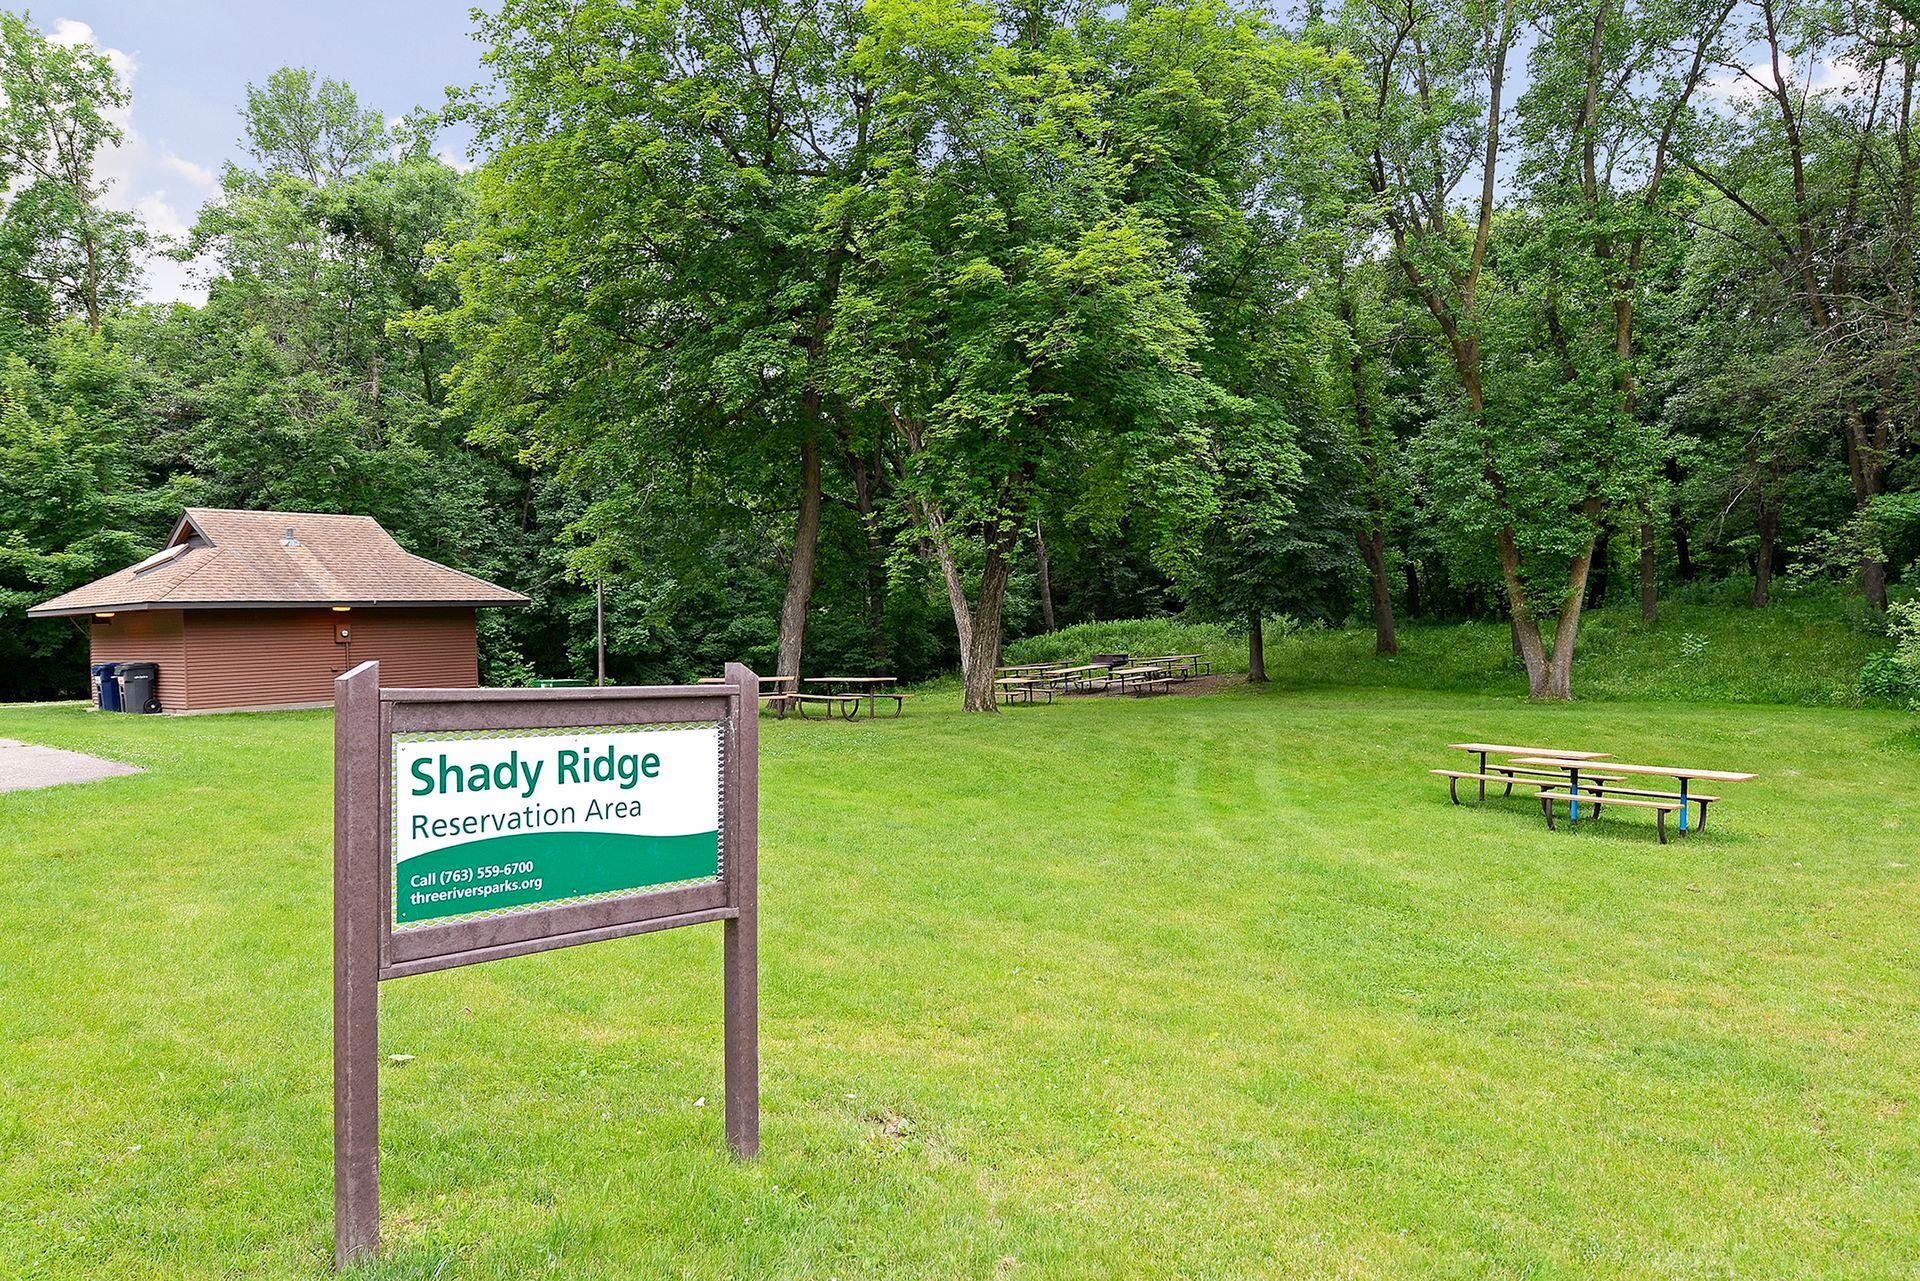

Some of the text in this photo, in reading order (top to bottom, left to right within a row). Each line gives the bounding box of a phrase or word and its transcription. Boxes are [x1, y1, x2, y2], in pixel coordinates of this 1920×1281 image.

[411, 745, 661, 798] Shady Ridge
[412, 799, 642, 840] Reservation Area
[410, 861, 534, 888] Call (763) 559-6700
[410, 876, 543, 905] threeriversparks.org
